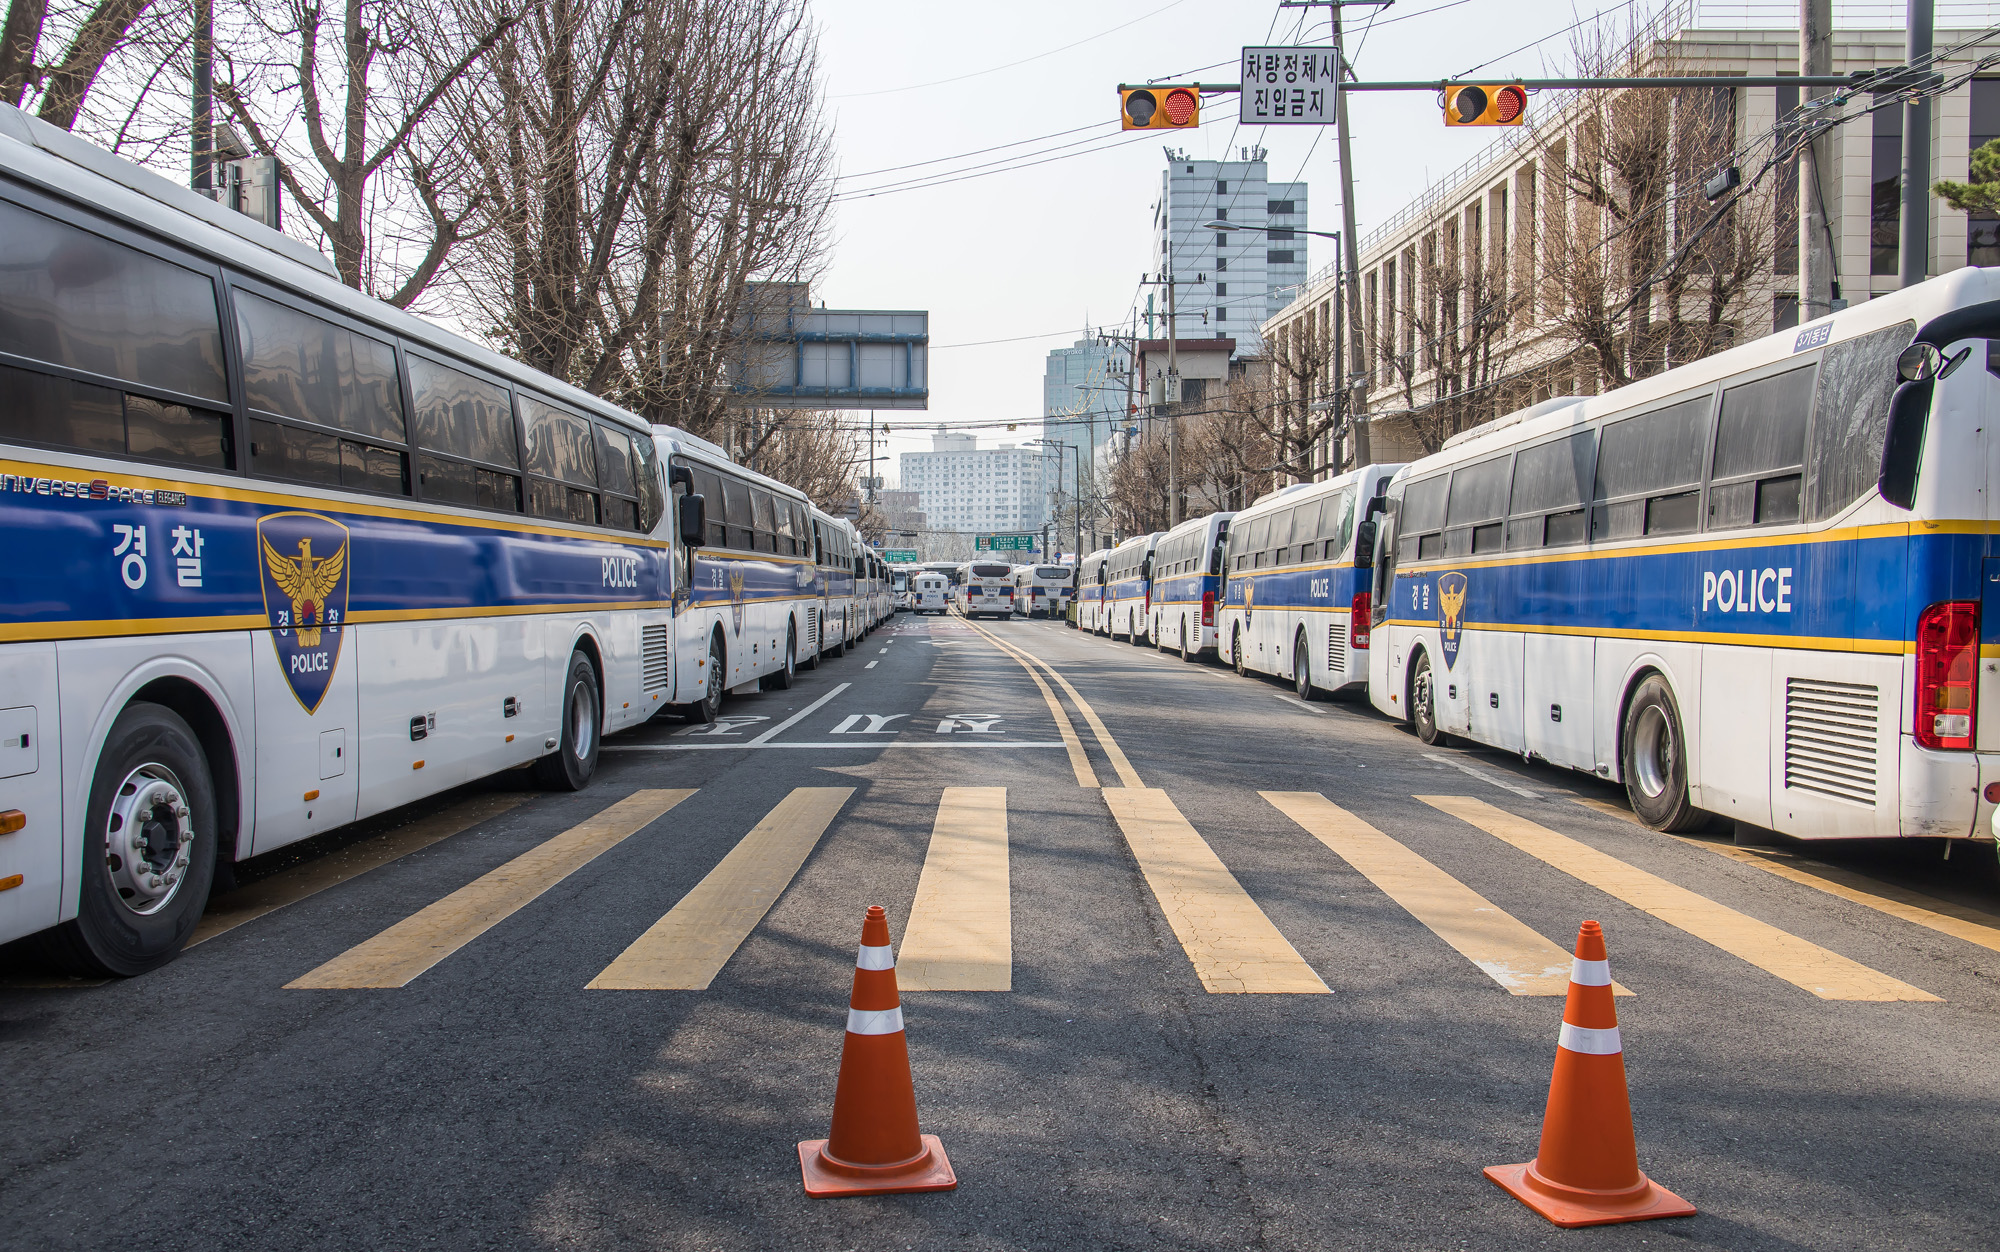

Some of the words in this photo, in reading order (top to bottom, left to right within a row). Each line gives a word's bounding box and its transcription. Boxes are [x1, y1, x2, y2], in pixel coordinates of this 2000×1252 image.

[1246, 54, 1335, 83] 차량정체시
[1254, 88, 1324, 117] 진입금지
[1797, 325, 1830, 347] 3기동단
[157, 490, 187, 505] ELEGANCE
[112, 523, 205, 590] 경찰
[601, 557, 638, 588] POLICE
[1310, 578, 1329, 598] POLICE
[1411, 583, 1430, 611] 경찰
[1702, 567, 1793, 613] POLICE
[1444, 641, 1457, 652] POLICE
[291, 651, 329, 674] POLICE
